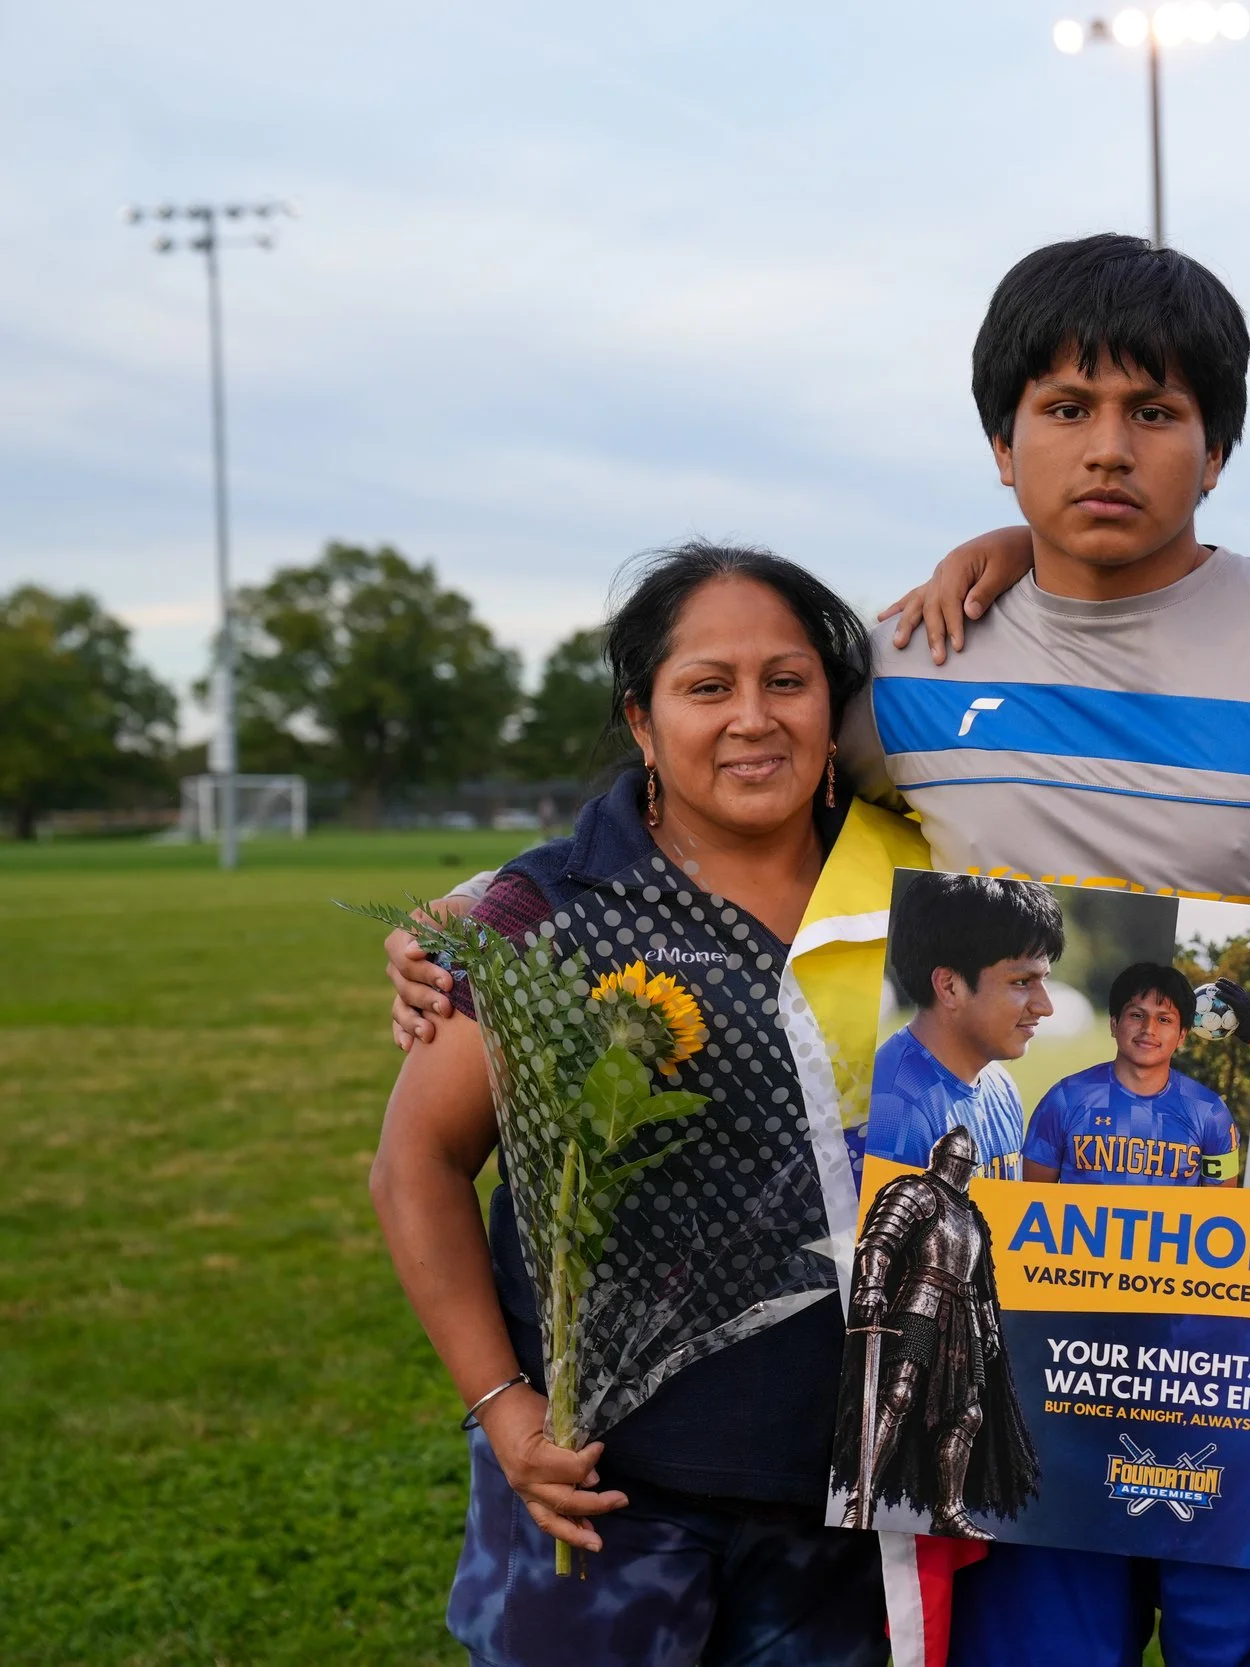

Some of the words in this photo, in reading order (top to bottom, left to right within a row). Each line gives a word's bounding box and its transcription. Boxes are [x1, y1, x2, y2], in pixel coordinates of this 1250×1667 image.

[645, 947, 729, 964] eMone
[1073, 1134, 1201, 1178] KNIGHTS
[1202, 1159, 1222, 1178] C
[1023, 1265, 1114, 1289] VARSITY
[1118, 1274, 1175, 1295] BOYS
[1047, 1338, 1129, 1369] YOUR
[1044, 1368, 1153, 1401] WATCH
[1160, 1380, 1220, 1407] HAS
[1044, 1400, 1071, 1413] BUT
[1074, 1402, 1113, 1418] ONCE
[1116, 1406, 1127, 1419] A
[1130, 1409, 1187, 1426] KNIGHT,
[1190, 1415, 1250, 1430] ALWAYS
[1110, 1458, 1218, 1493] FOUNDATION
[1121, 1485, 1203, 1501] ACADEMIES
